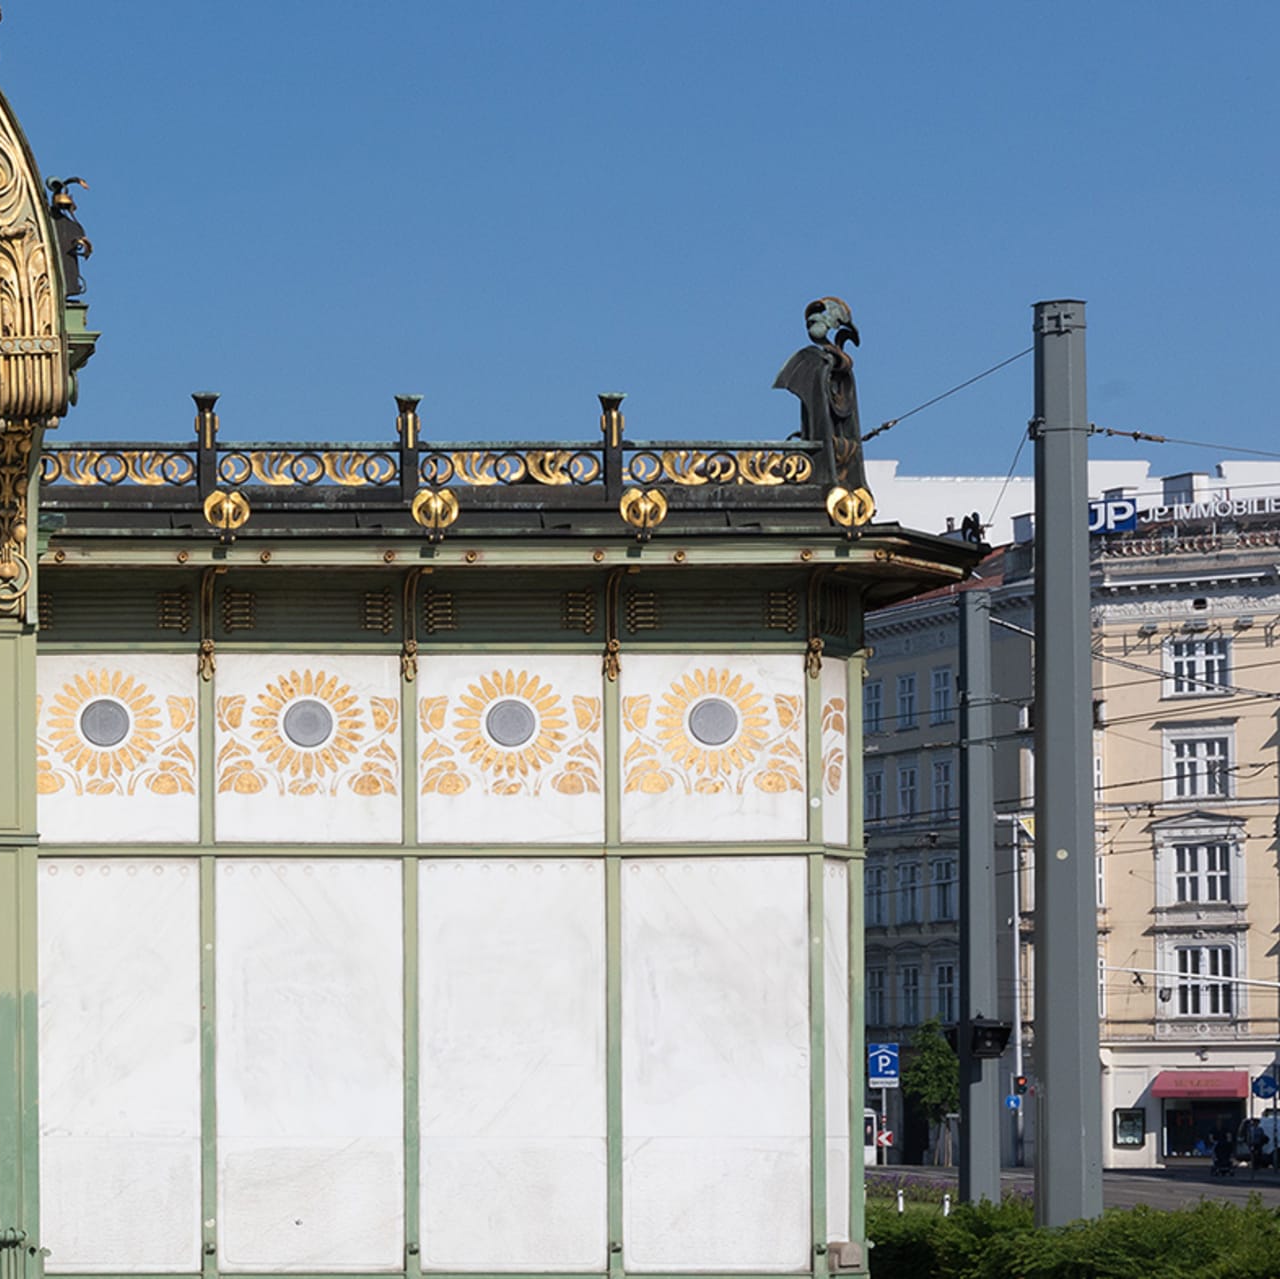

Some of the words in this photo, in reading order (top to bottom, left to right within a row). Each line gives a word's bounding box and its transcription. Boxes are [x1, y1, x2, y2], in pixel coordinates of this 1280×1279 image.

[1088, 501, 1134, 530] JP
[1141, 505, 1168, 523] JP
[878, 1055, 891, 1072] P
